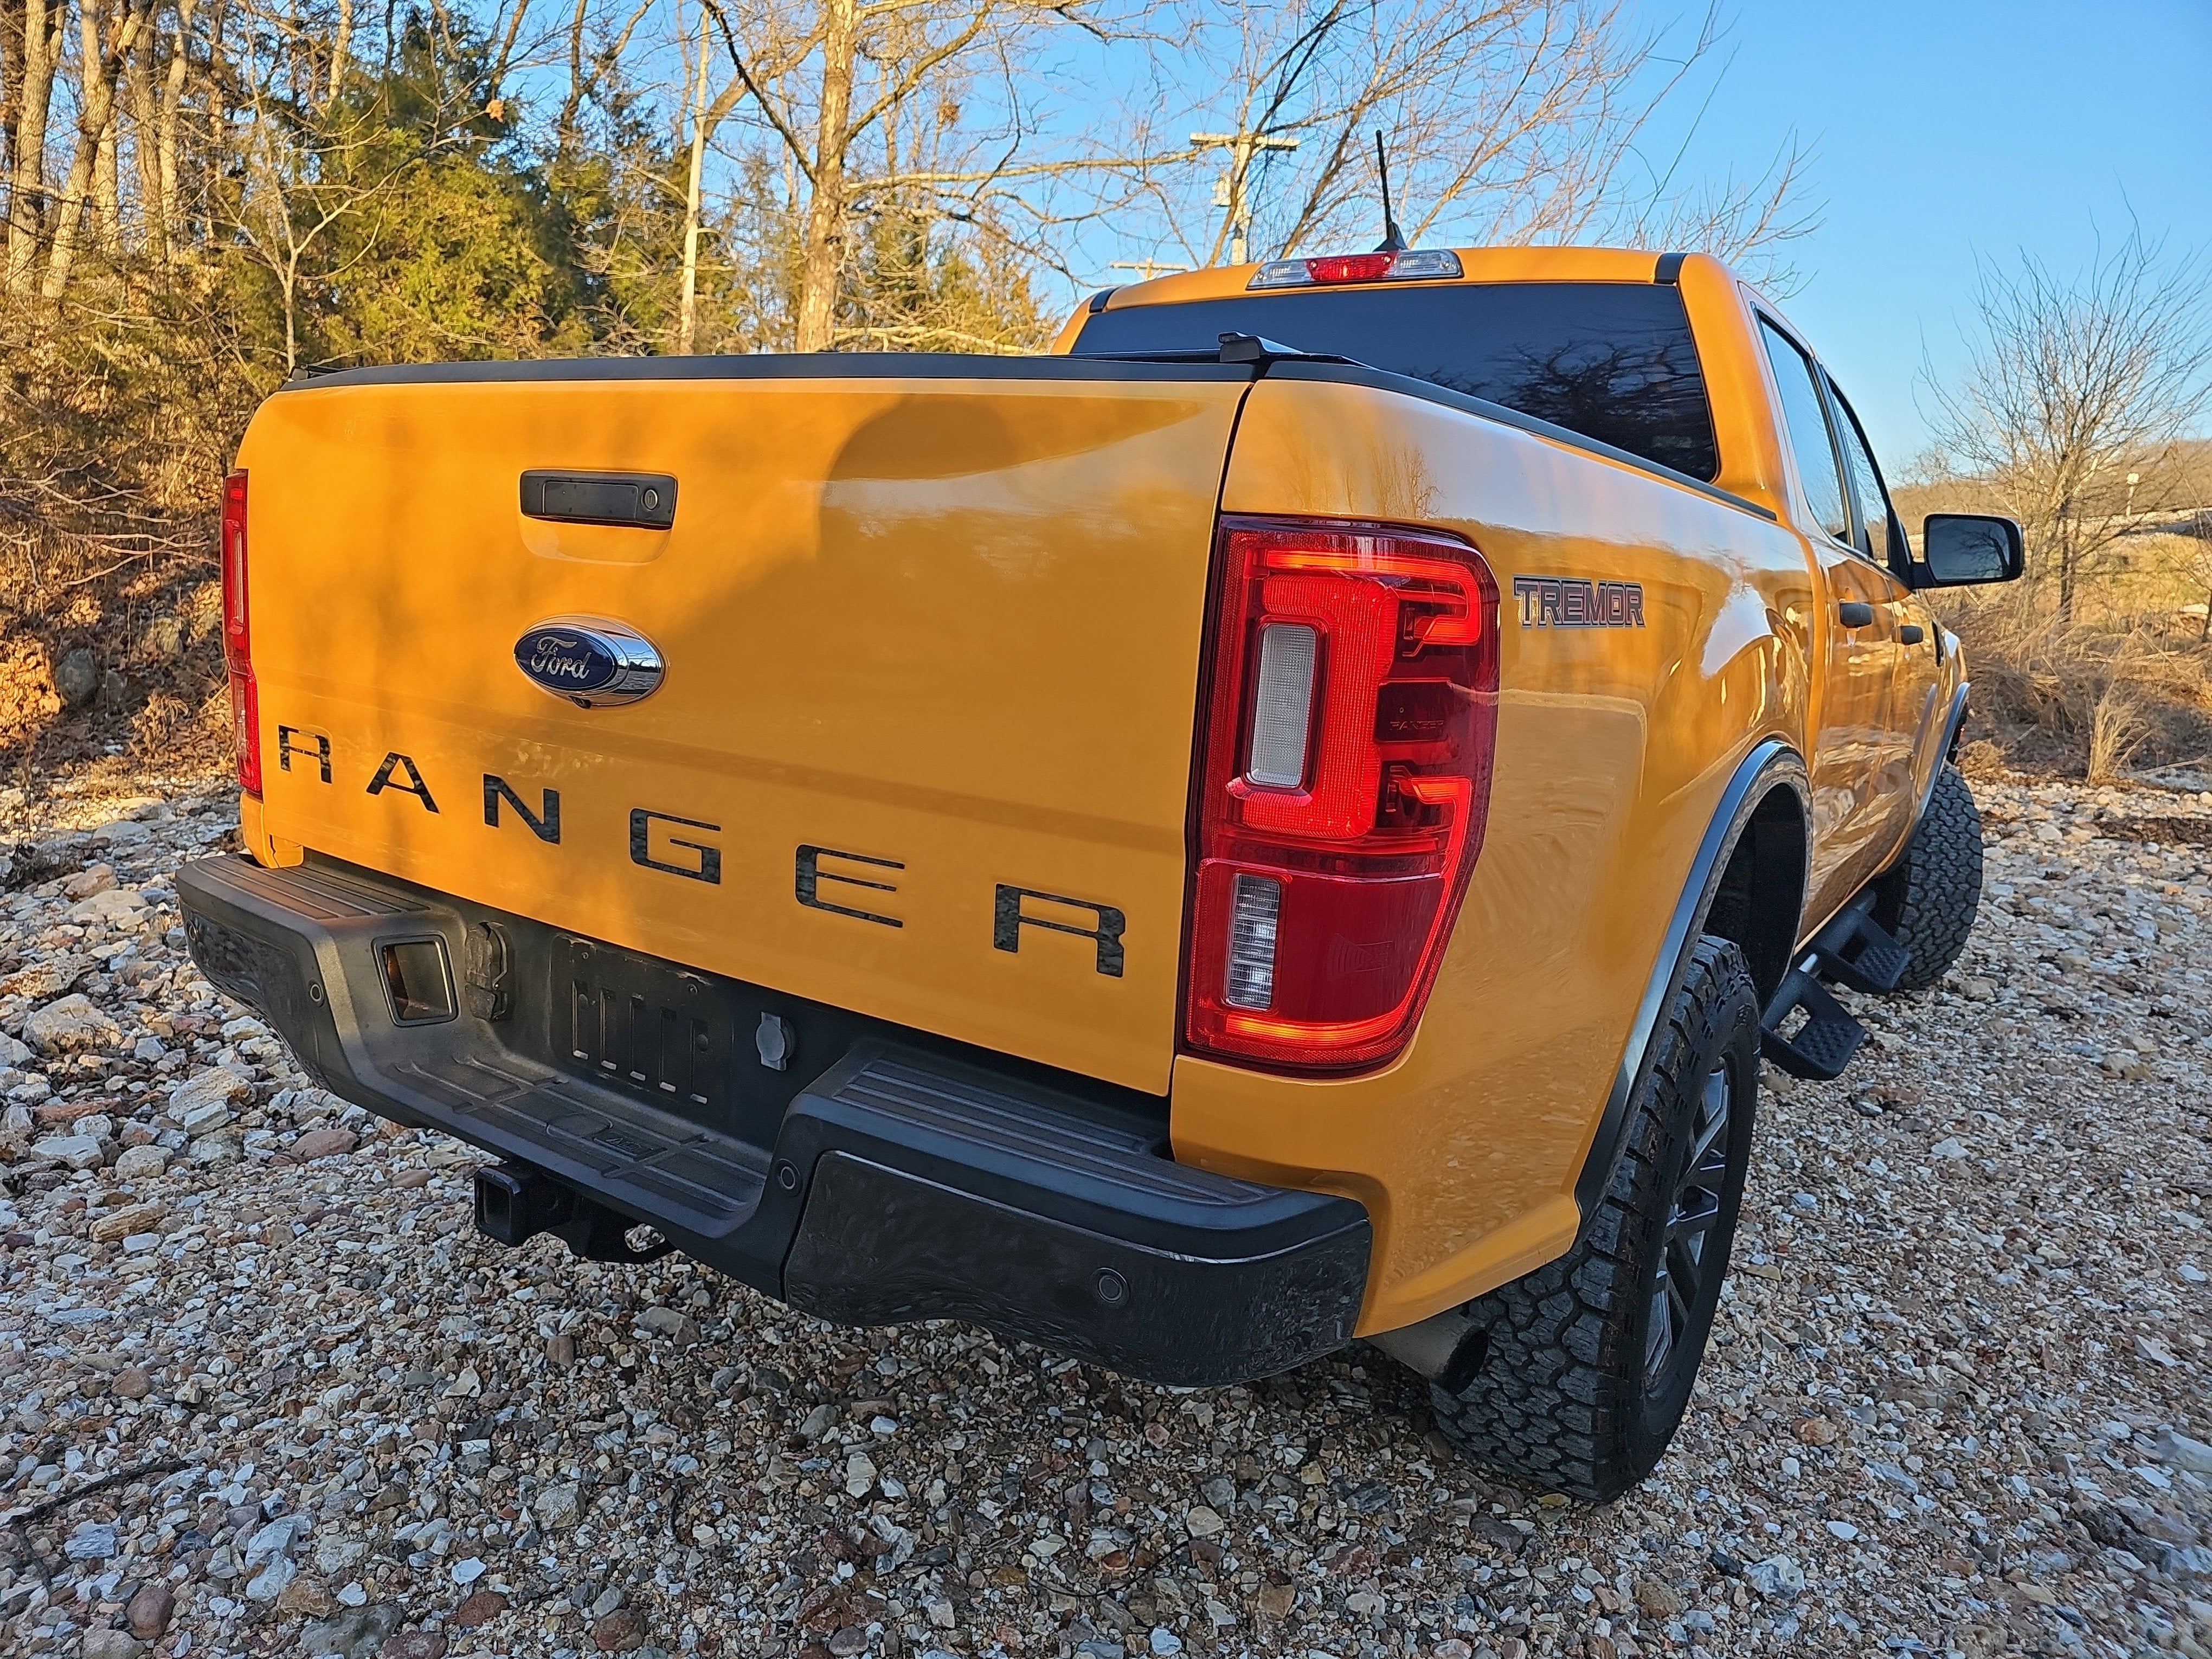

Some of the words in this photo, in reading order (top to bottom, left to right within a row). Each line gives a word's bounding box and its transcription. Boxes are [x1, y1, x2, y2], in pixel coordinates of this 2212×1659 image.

[1513, 575, 1645, 628] TREMOR
[531, 636, 590, 679] Ford
[278, 725, 1126, 978] RANGER
